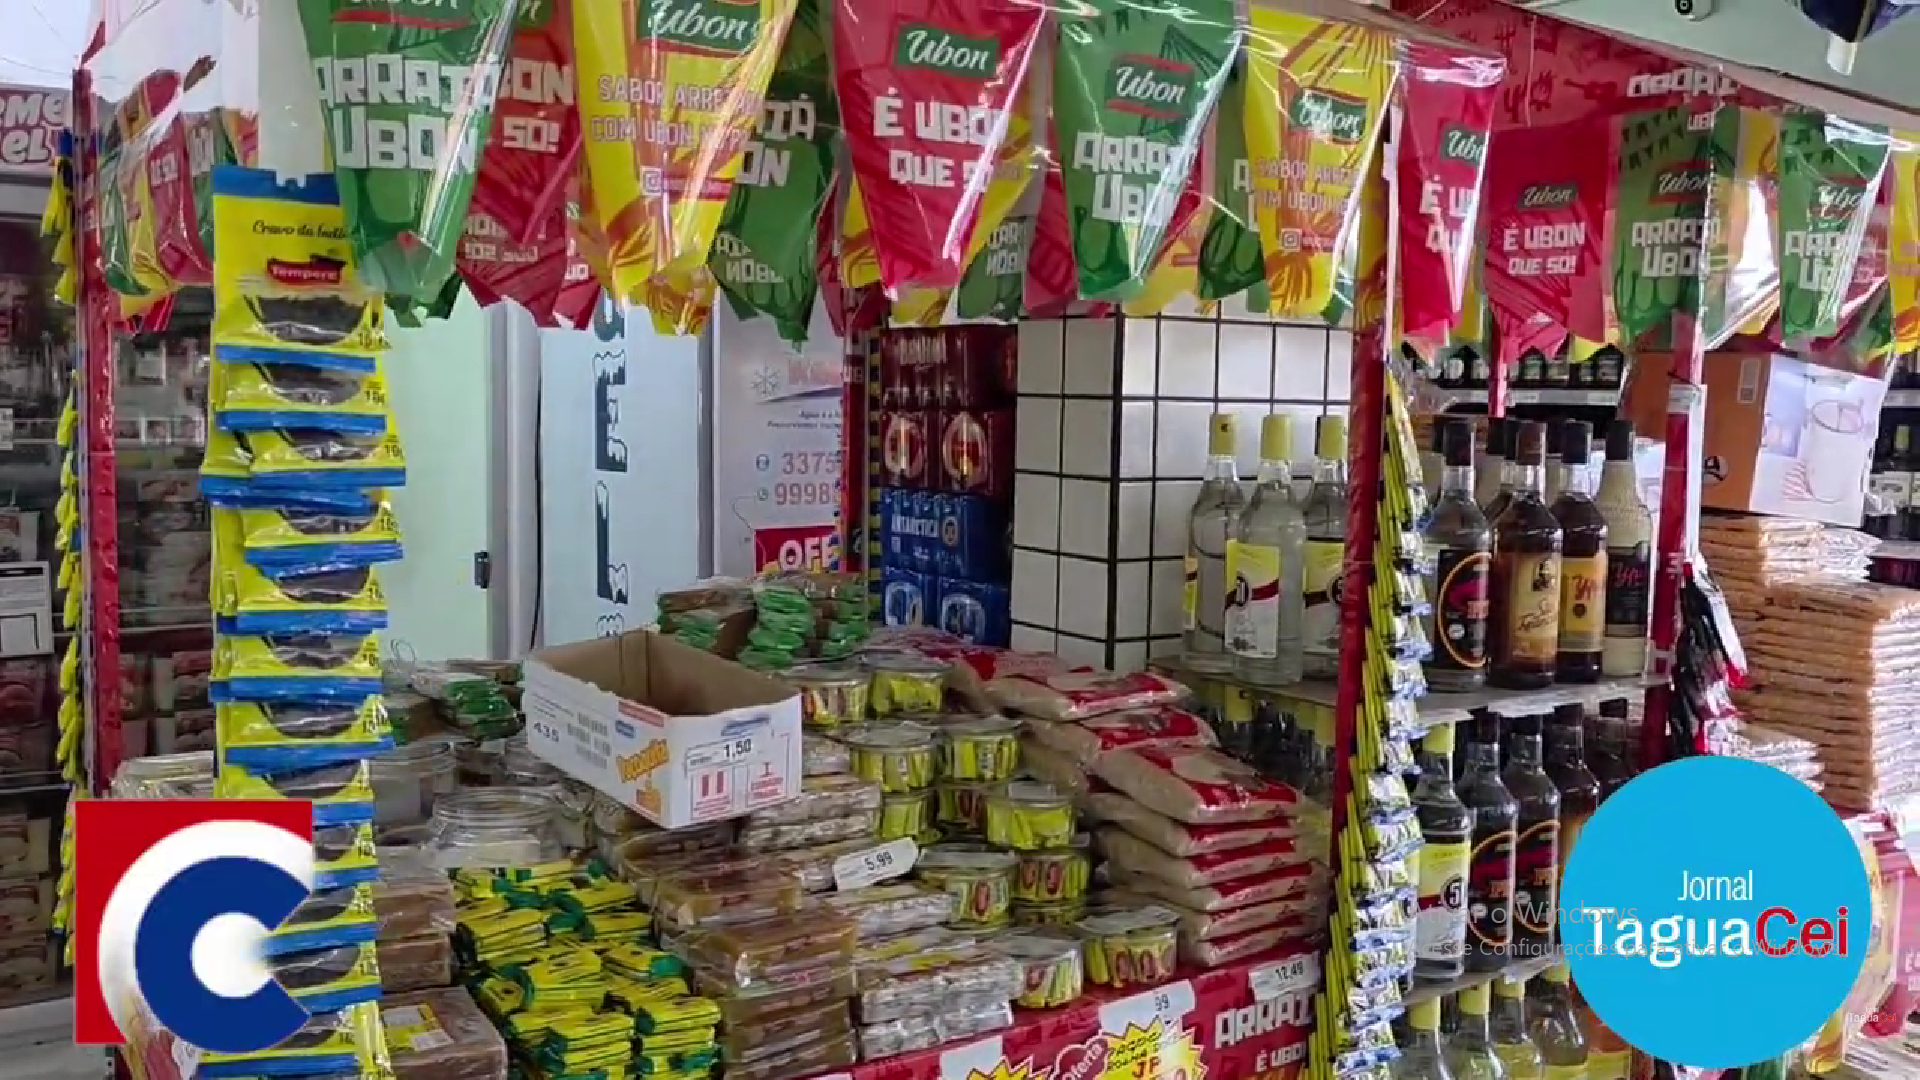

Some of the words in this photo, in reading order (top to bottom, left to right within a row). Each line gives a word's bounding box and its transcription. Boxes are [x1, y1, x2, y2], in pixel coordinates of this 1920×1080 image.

[906, 28, 991, 71] Ubon
[598, 74, 664, 107] SABOR
[1115, 65, 1186, 105] Ubon
[591, 117, 637, 141] COM
[644, 120, 694, 146] UBON
[889, 150, 955, 187] QUE
[1522, 185, 1574, 207] Ubon
[1524, 221, 1586, 250] UBON
[1508, 256, 1543, 276] QUE
